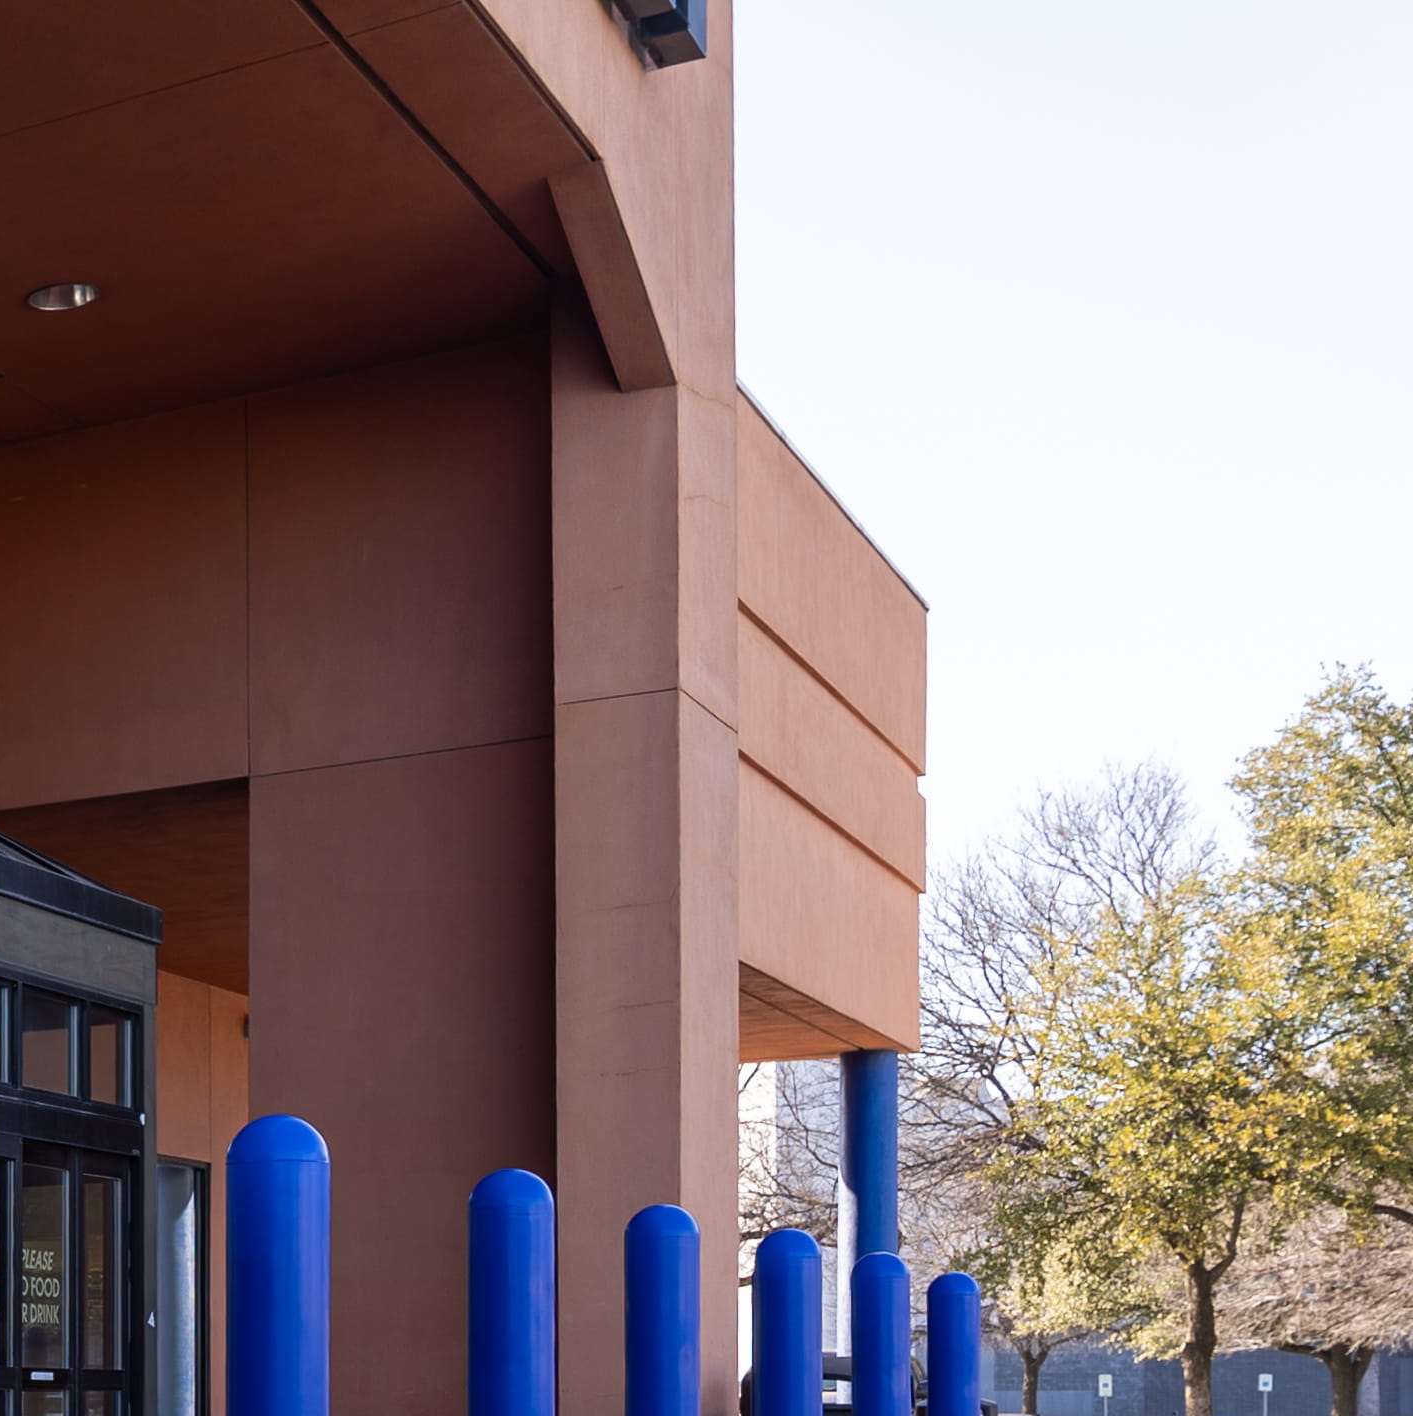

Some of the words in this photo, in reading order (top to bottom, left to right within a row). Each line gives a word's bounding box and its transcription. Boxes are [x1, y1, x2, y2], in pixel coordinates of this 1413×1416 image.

[22, 1248, 54, 1271] PLEASE
[31, 1277, 60, 1298] FOOD
[30, 1303, 60, 1325] DRINK
